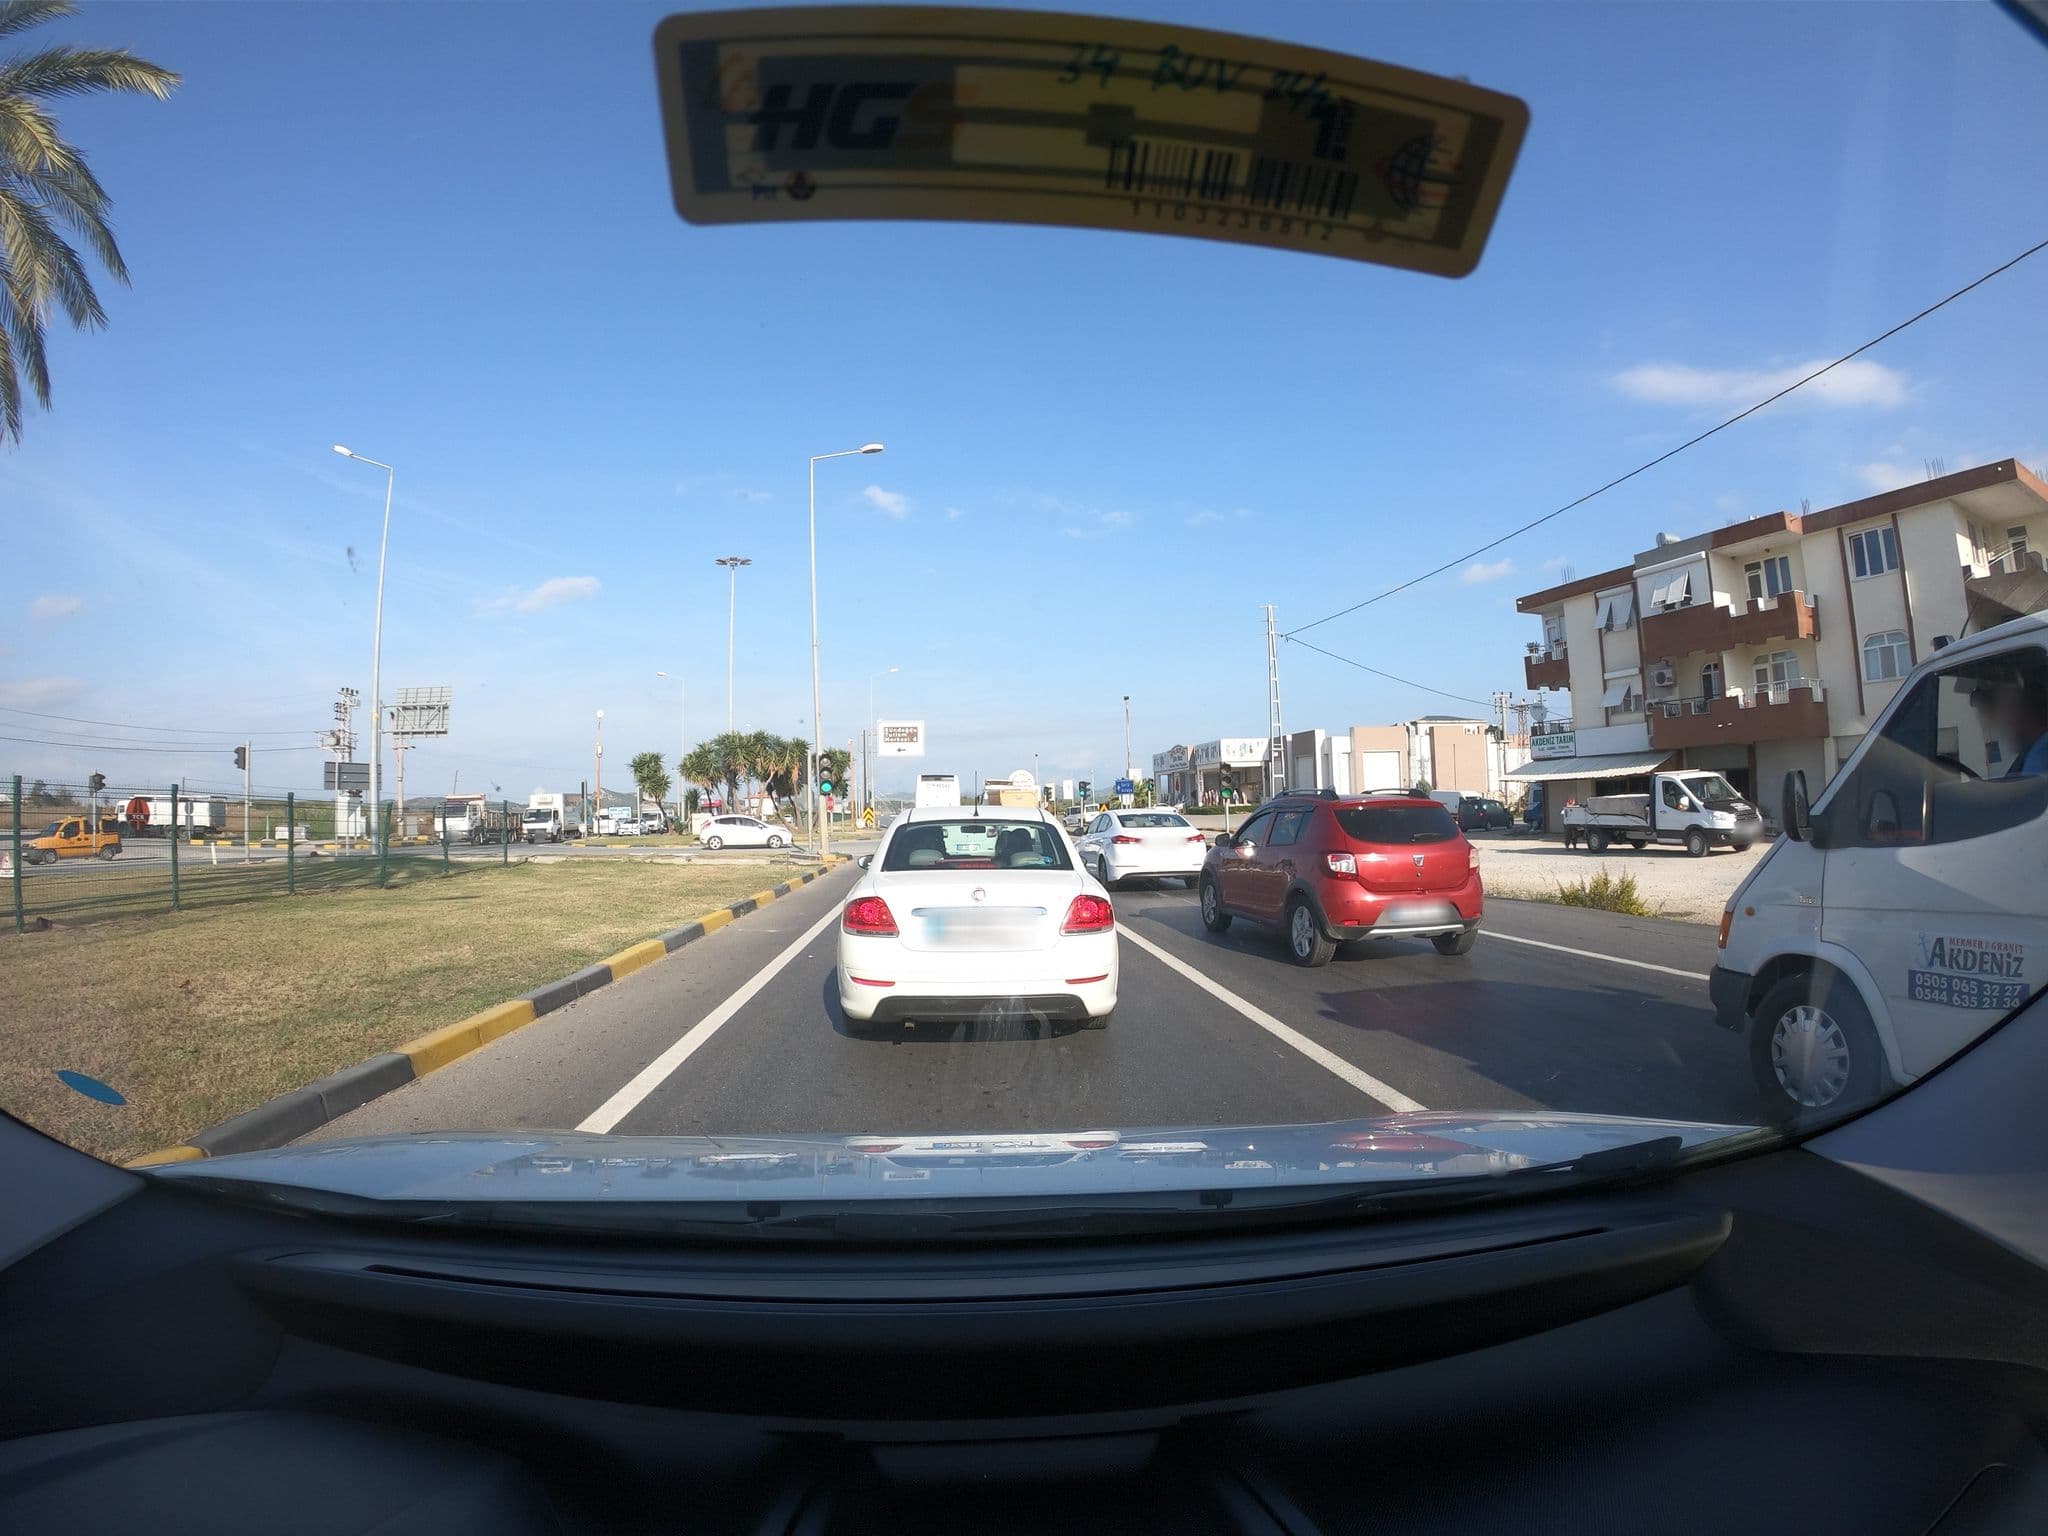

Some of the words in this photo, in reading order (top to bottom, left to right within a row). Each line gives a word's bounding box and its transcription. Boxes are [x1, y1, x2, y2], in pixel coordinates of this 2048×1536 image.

[1915, 973, 1948, 988] 0505
[1952, 978, 1979, 994] 065
[1983, 984, 2000, 996] 32
[2004, 985, 2022, 996] 27
[1915, 987, 1948, 1003] 0544
[1952, 993, 1979, 1007] 635
[1983, 997, 1999, 1008] 21
